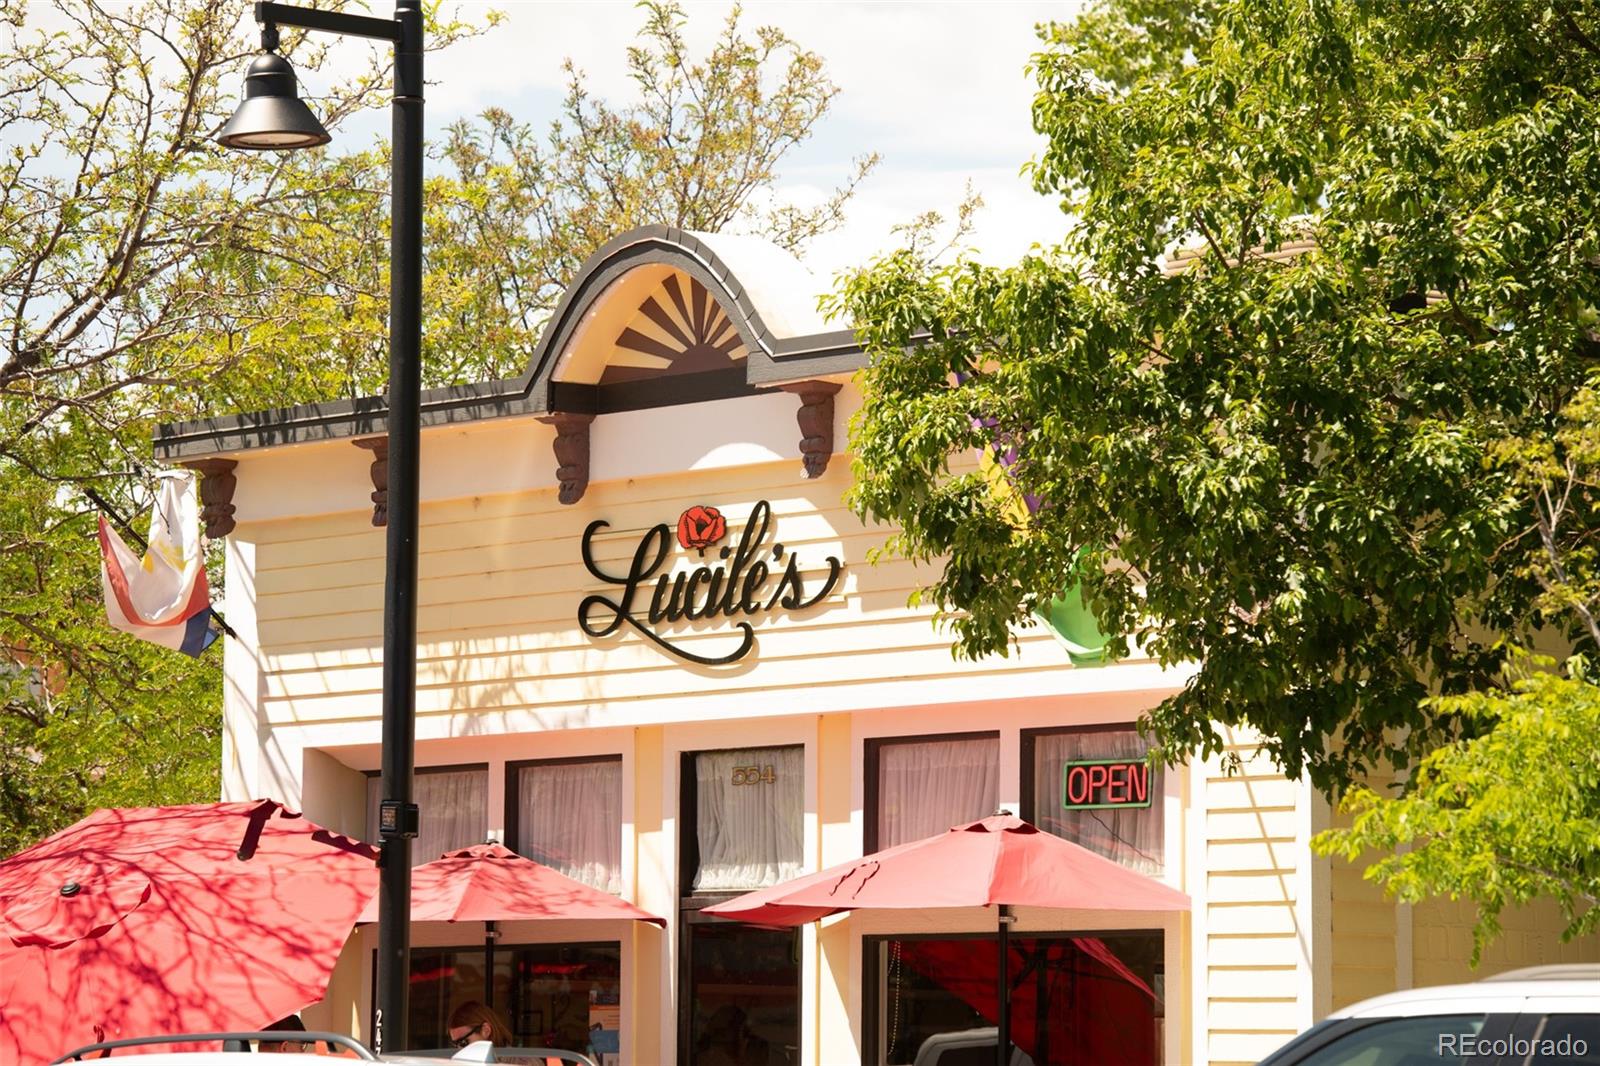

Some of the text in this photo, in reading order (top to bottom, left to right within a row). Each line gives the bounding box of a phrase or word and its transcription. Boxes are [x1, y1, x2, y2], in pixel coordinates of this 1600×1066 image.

[578, 500, 841, 666] Lucile's
[731, 765, 776, 785] 554
[1068, 764, 1149, 803] OPEN
